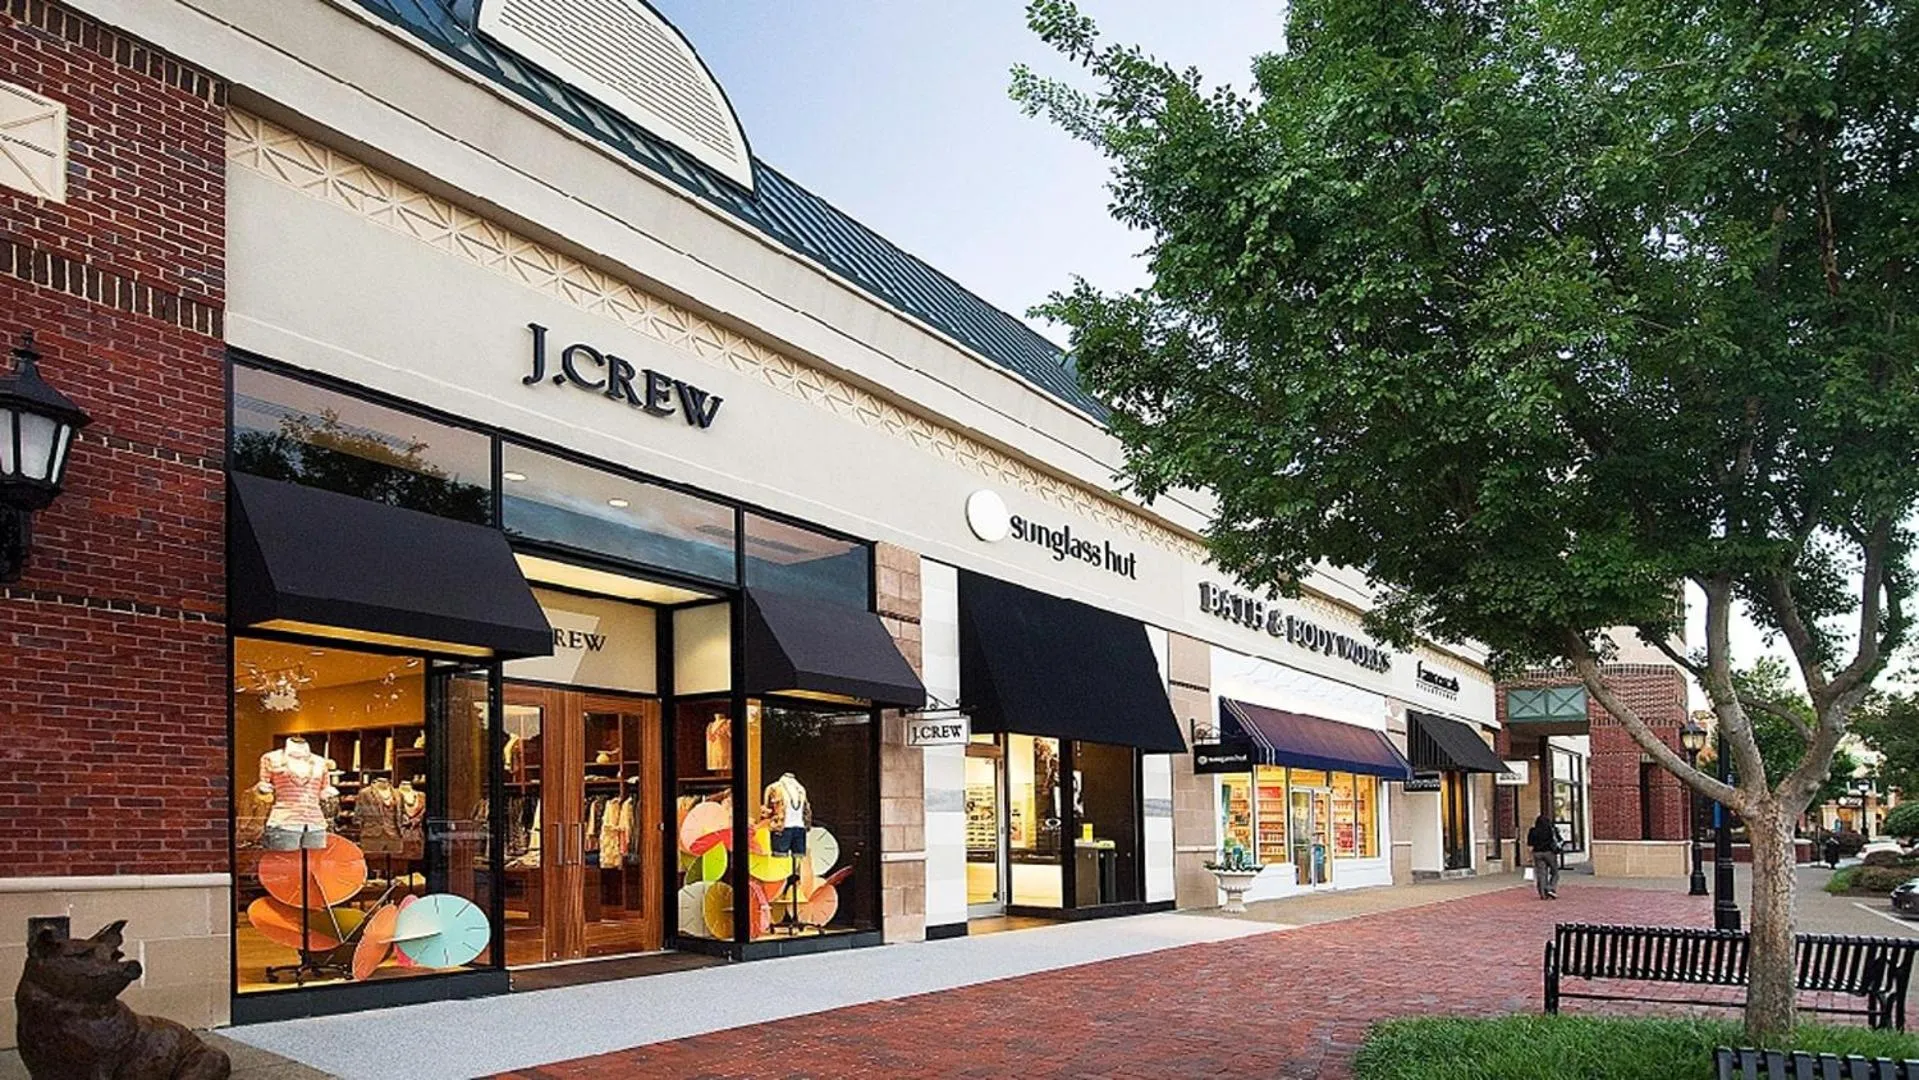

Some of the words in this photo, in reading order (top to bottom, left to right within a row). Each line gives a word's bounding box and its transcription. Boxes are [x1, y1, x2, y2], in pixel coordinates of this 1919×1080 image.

[522, 322, 724, 429] J.CREW
[1009, 514, 1101, 567] sunglass
[1104, 540, 1137, 580] hut
[553, 627, 606, 652] REW
[1199, 581, 1265, 632] BATH
[1266, 609, 1285, 637] &
[1286, 614, 1337, 656] BODY
[912, 724, 962, 744] J.CREW
